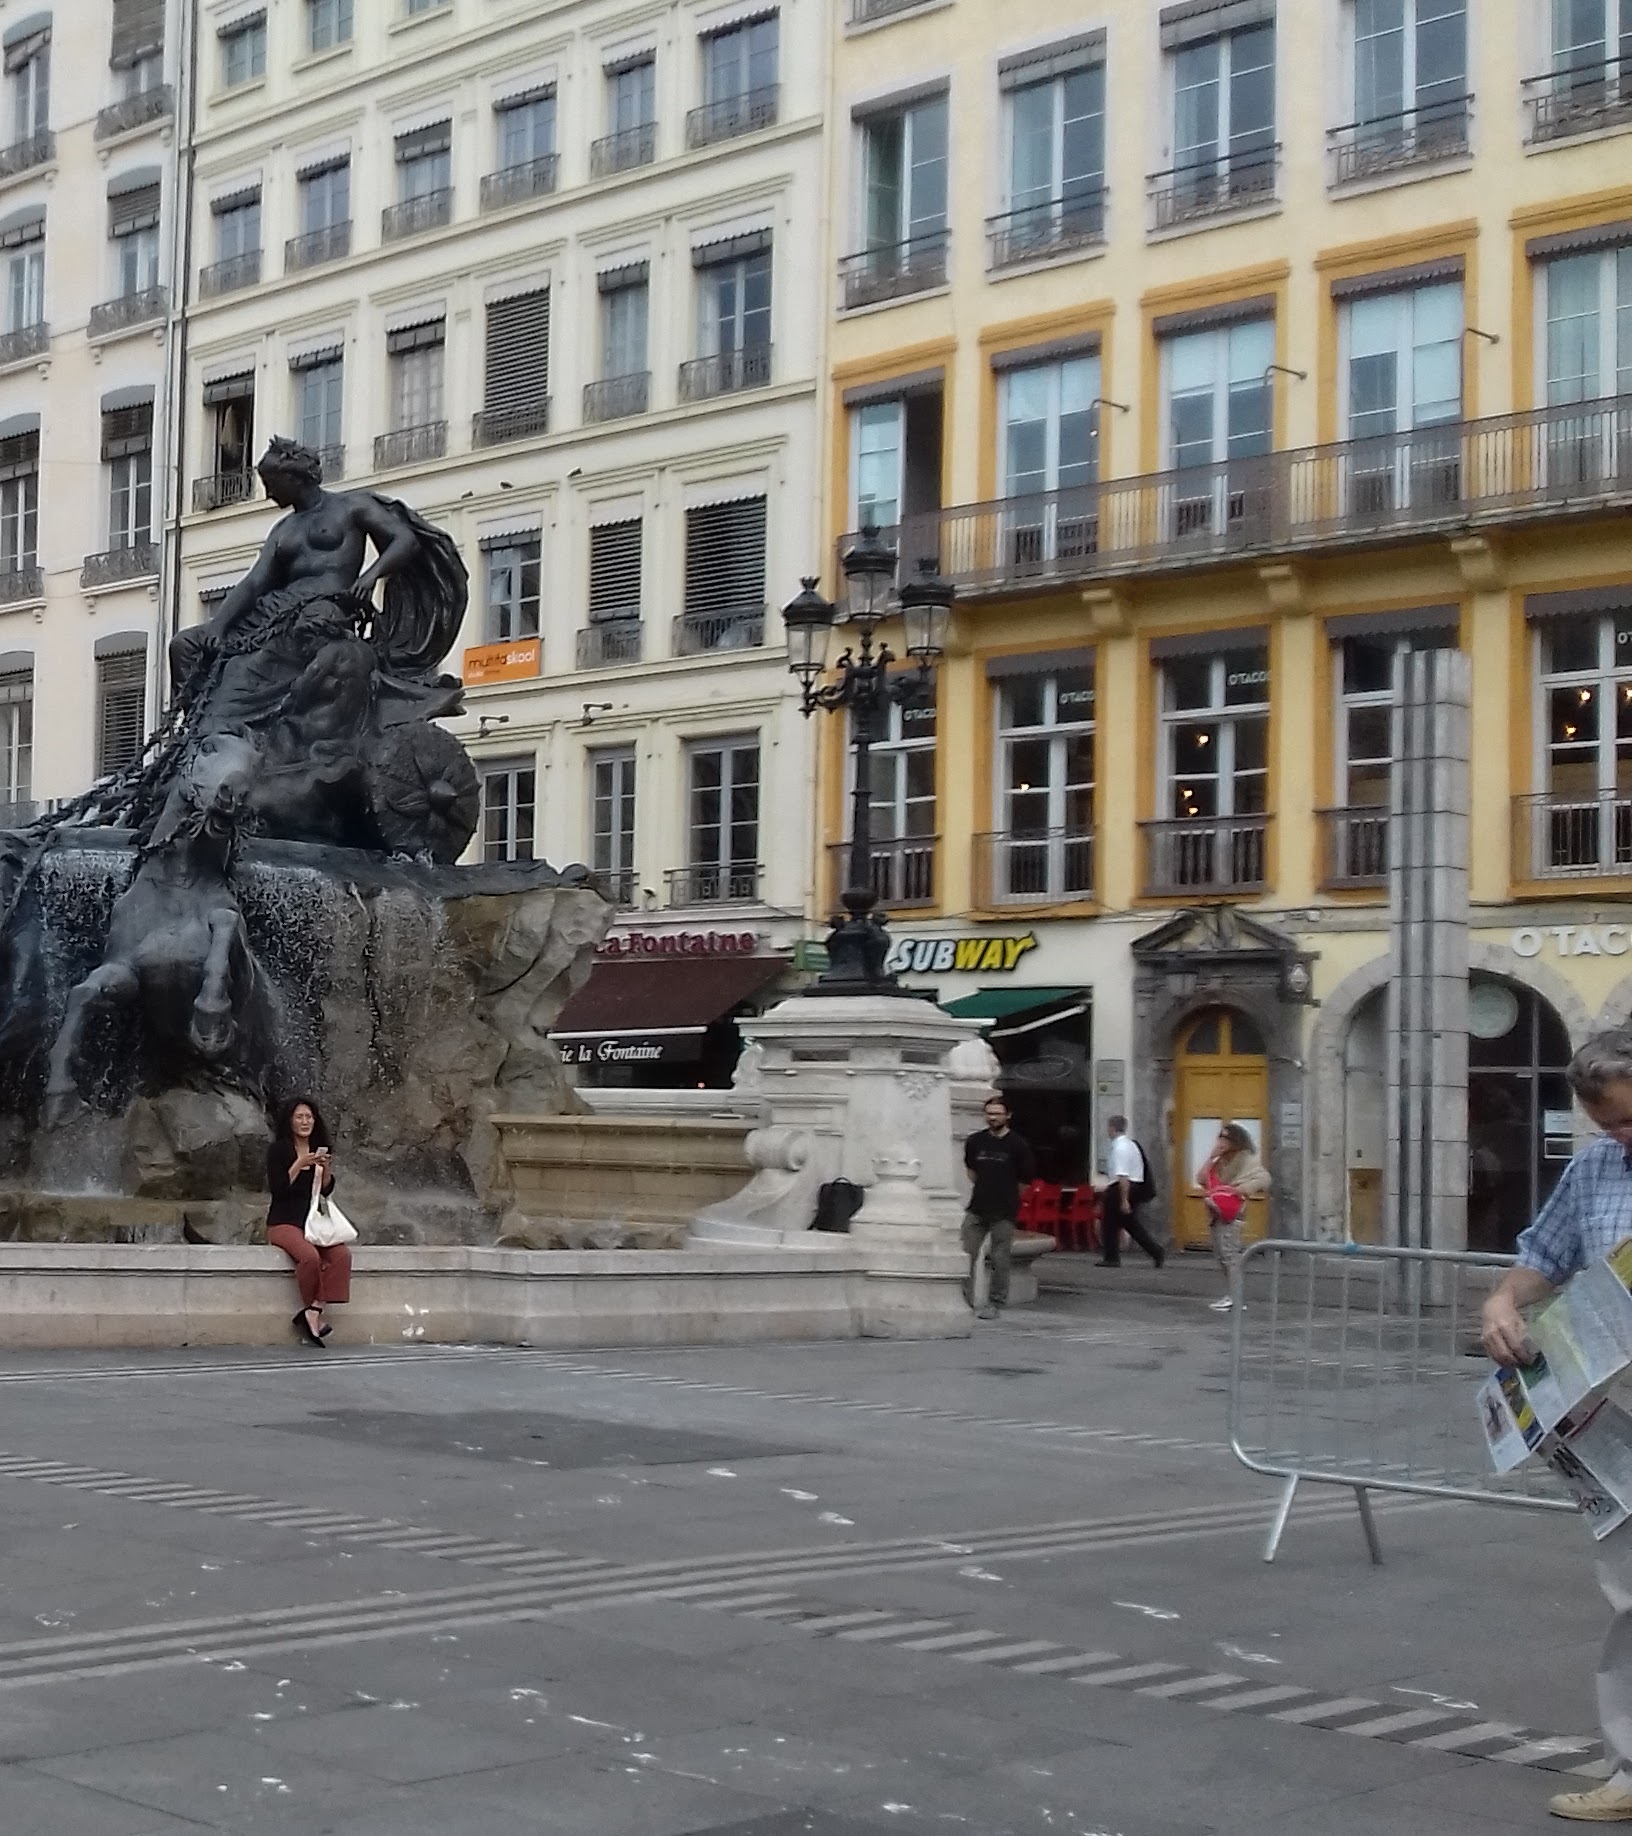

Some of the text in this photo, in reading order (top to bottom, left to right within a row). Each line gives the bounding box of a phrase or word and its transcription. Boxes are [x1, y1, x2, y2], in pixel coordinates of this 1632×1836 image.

[595, 930, 754, 954] a Fontaine
[887, 931, 1037, 972] SUBWAY
[597, 1040, 663, 1061] Fontaine
